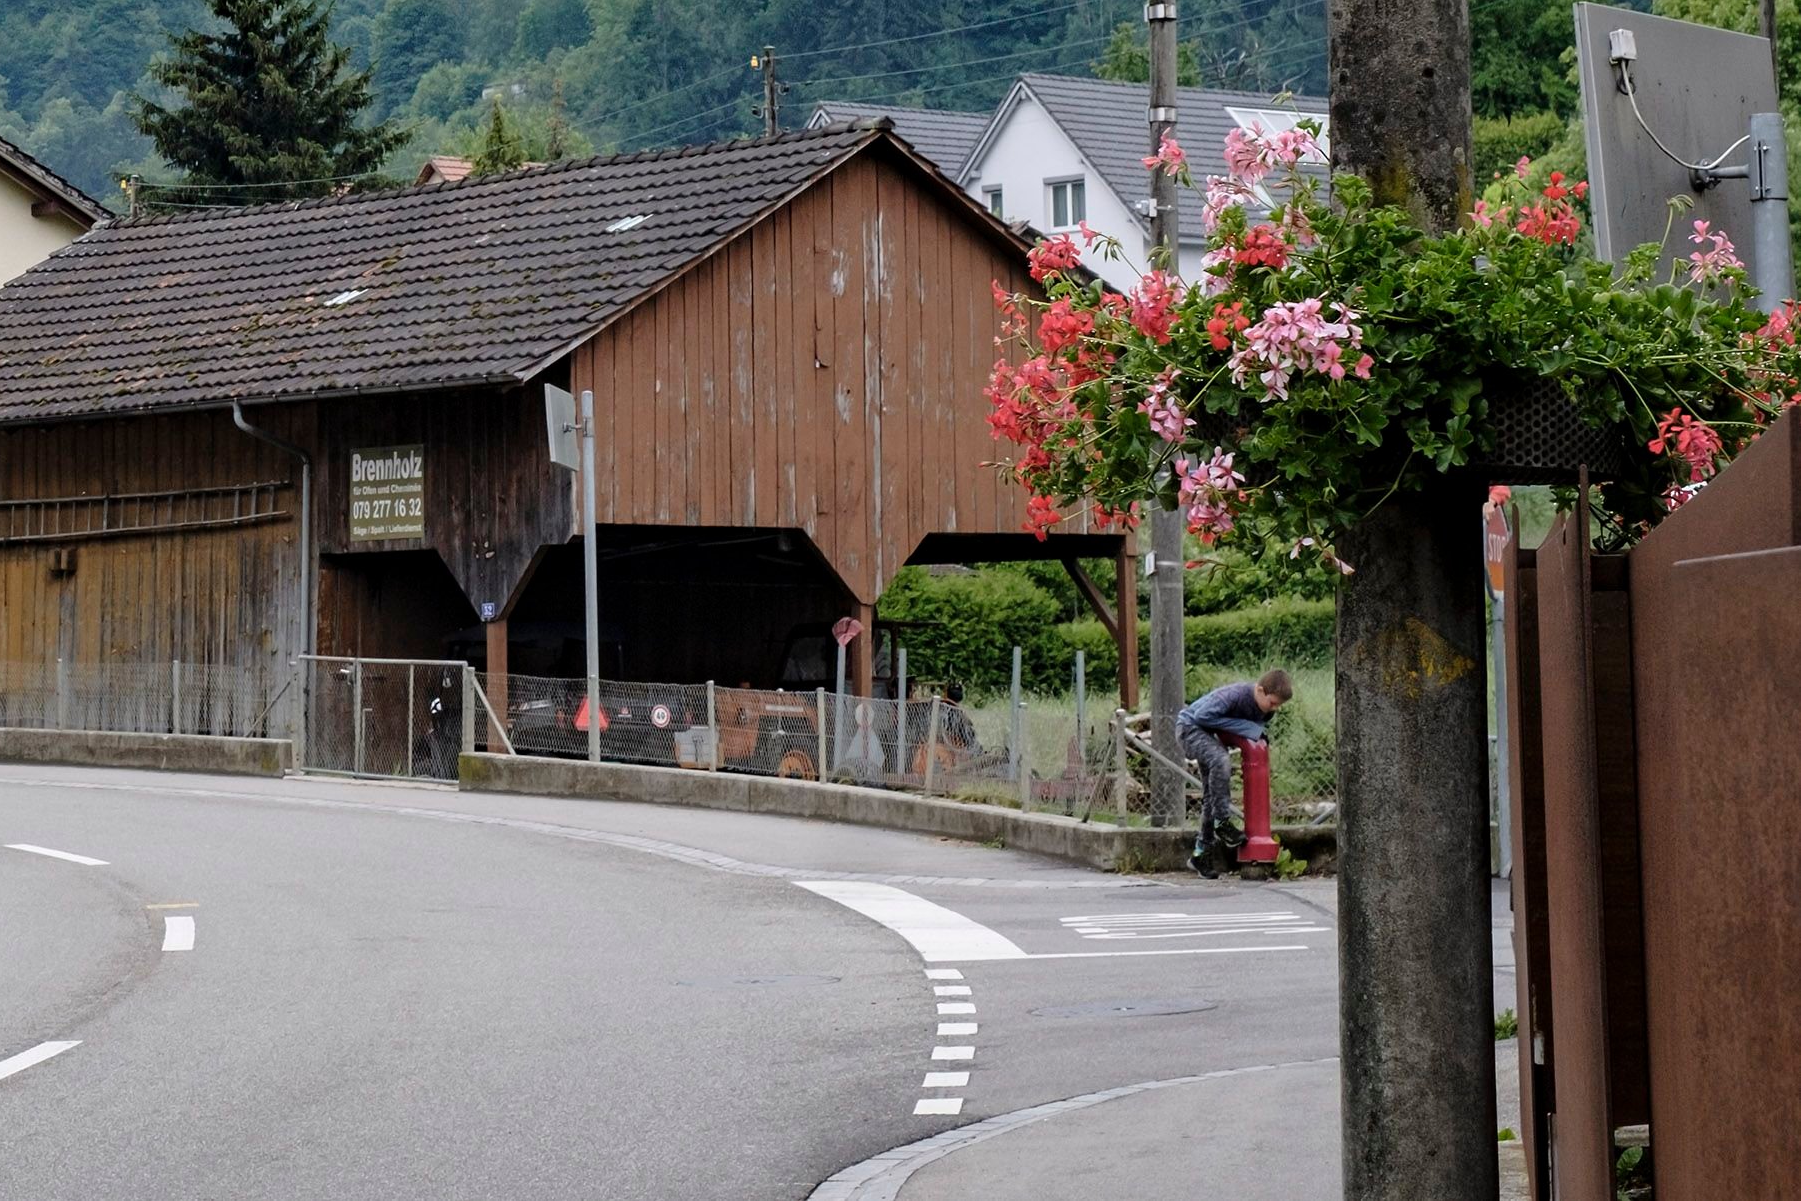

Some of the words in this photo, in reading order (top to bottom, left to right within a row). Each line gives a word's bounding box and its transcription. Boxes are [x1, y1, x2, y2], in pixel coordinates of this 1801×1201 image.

[352, 450, 423, 482] Brennholz
[362, 485, 377, 495] Ofen
[377, 484, 390, 494] und
[353, 500, 370, 519] 079
[373, 500, 392, 518] 277
[394, 498, 406, 517] 16
[409, 498, 422, 517] 32
